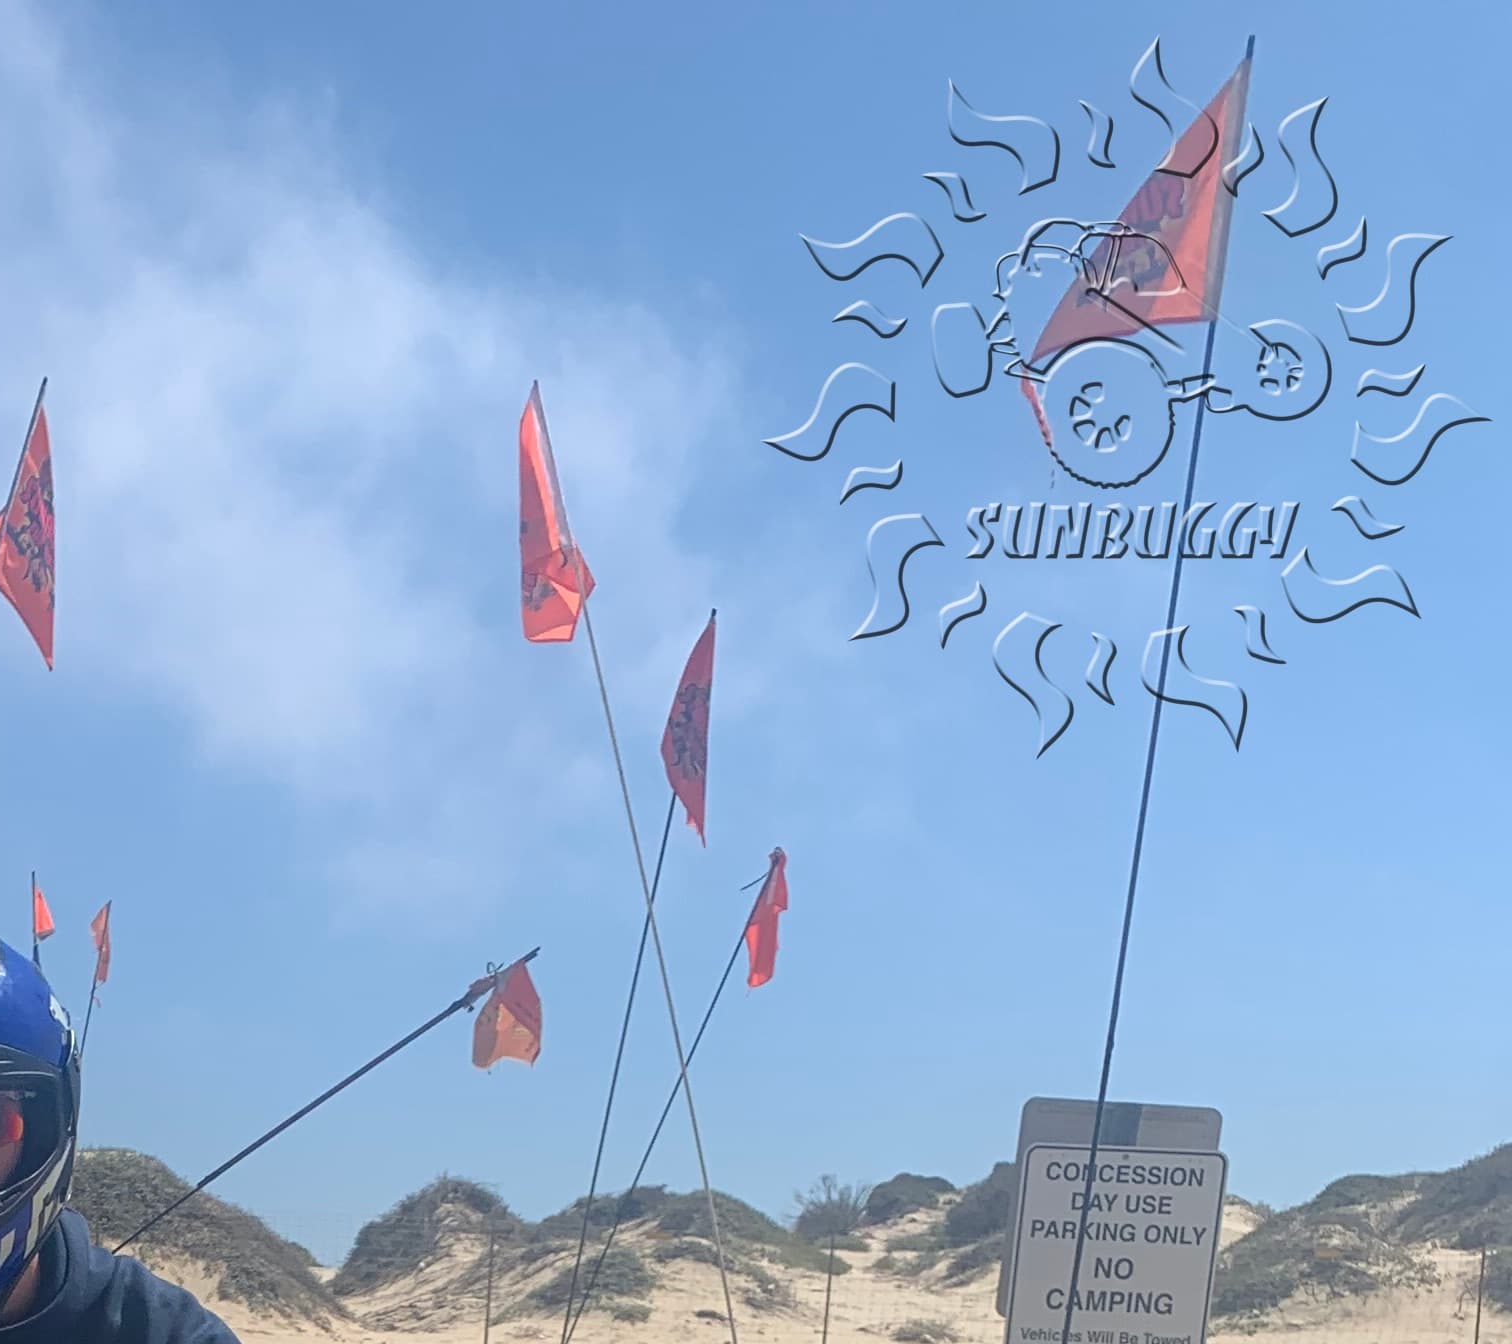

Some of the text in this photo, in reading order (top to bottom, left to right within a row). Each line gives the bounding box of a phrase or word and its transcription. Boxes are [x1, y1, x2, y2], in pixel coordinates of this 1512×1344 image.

[1045, 1161, 1205, 1187] CONCESSION
[1071, 1191, 1173, 1215] DAY USE
[1029, 1218, 1207, 1246] PARKING ONLY
[1093, 1256, 1134, 1280] NO
[1045, 1287, 1174, 1315] CAMPING
[1020, 1327, 1083, 1343] Vehices
[1087, 1330, 1115, 1344] Will
